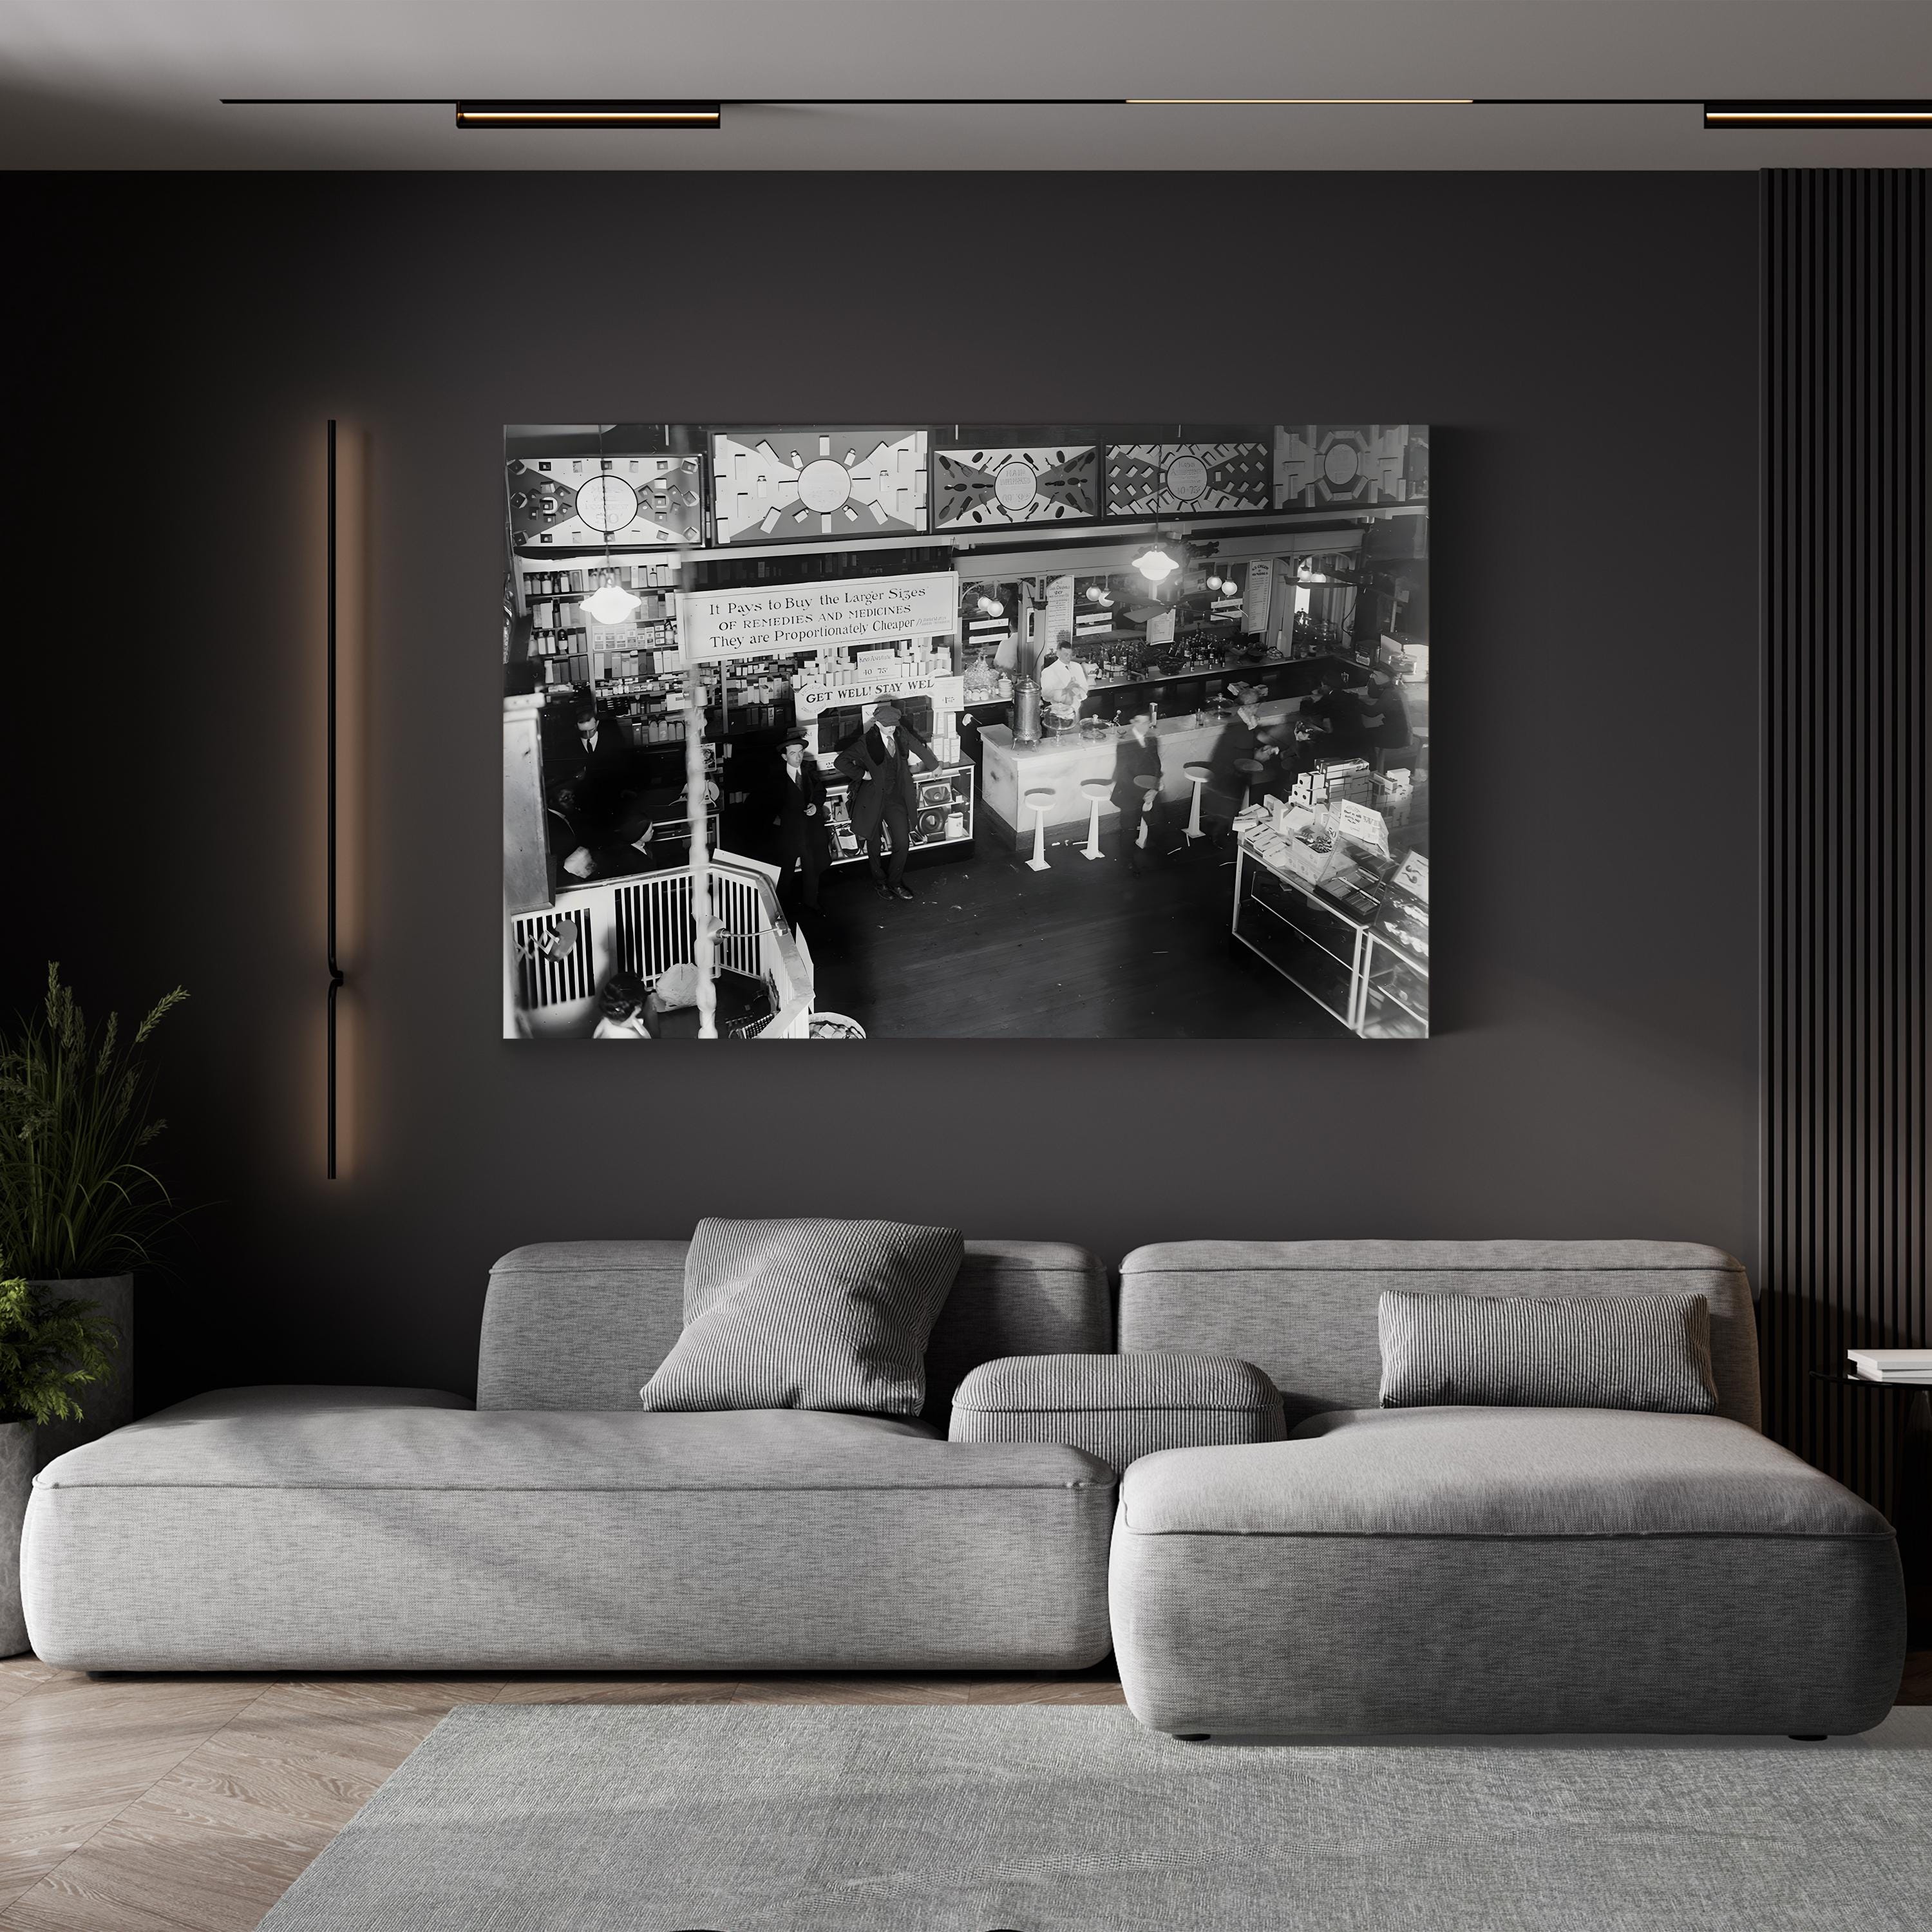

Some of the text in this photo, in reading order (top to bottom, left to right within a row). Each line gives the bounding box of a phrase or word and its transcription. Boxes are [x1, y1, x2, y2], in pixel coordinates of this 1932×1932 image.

[710, 588, 926, 616] It Pays to Buy the Larger Sizes
[719, 605, 911, 631] OF REMEDIES AND MEDICINES
[709, 636, 744, 649] They
[750, 634, 770, 644] are
[775, 623, 868, 642] Proportionately
[873, 619, 915, 631] Cheaper
[806, 692, 833, 703] GET
[838, 686, 871, 699] WELL!
[875, 683, 902, 695] STAY
